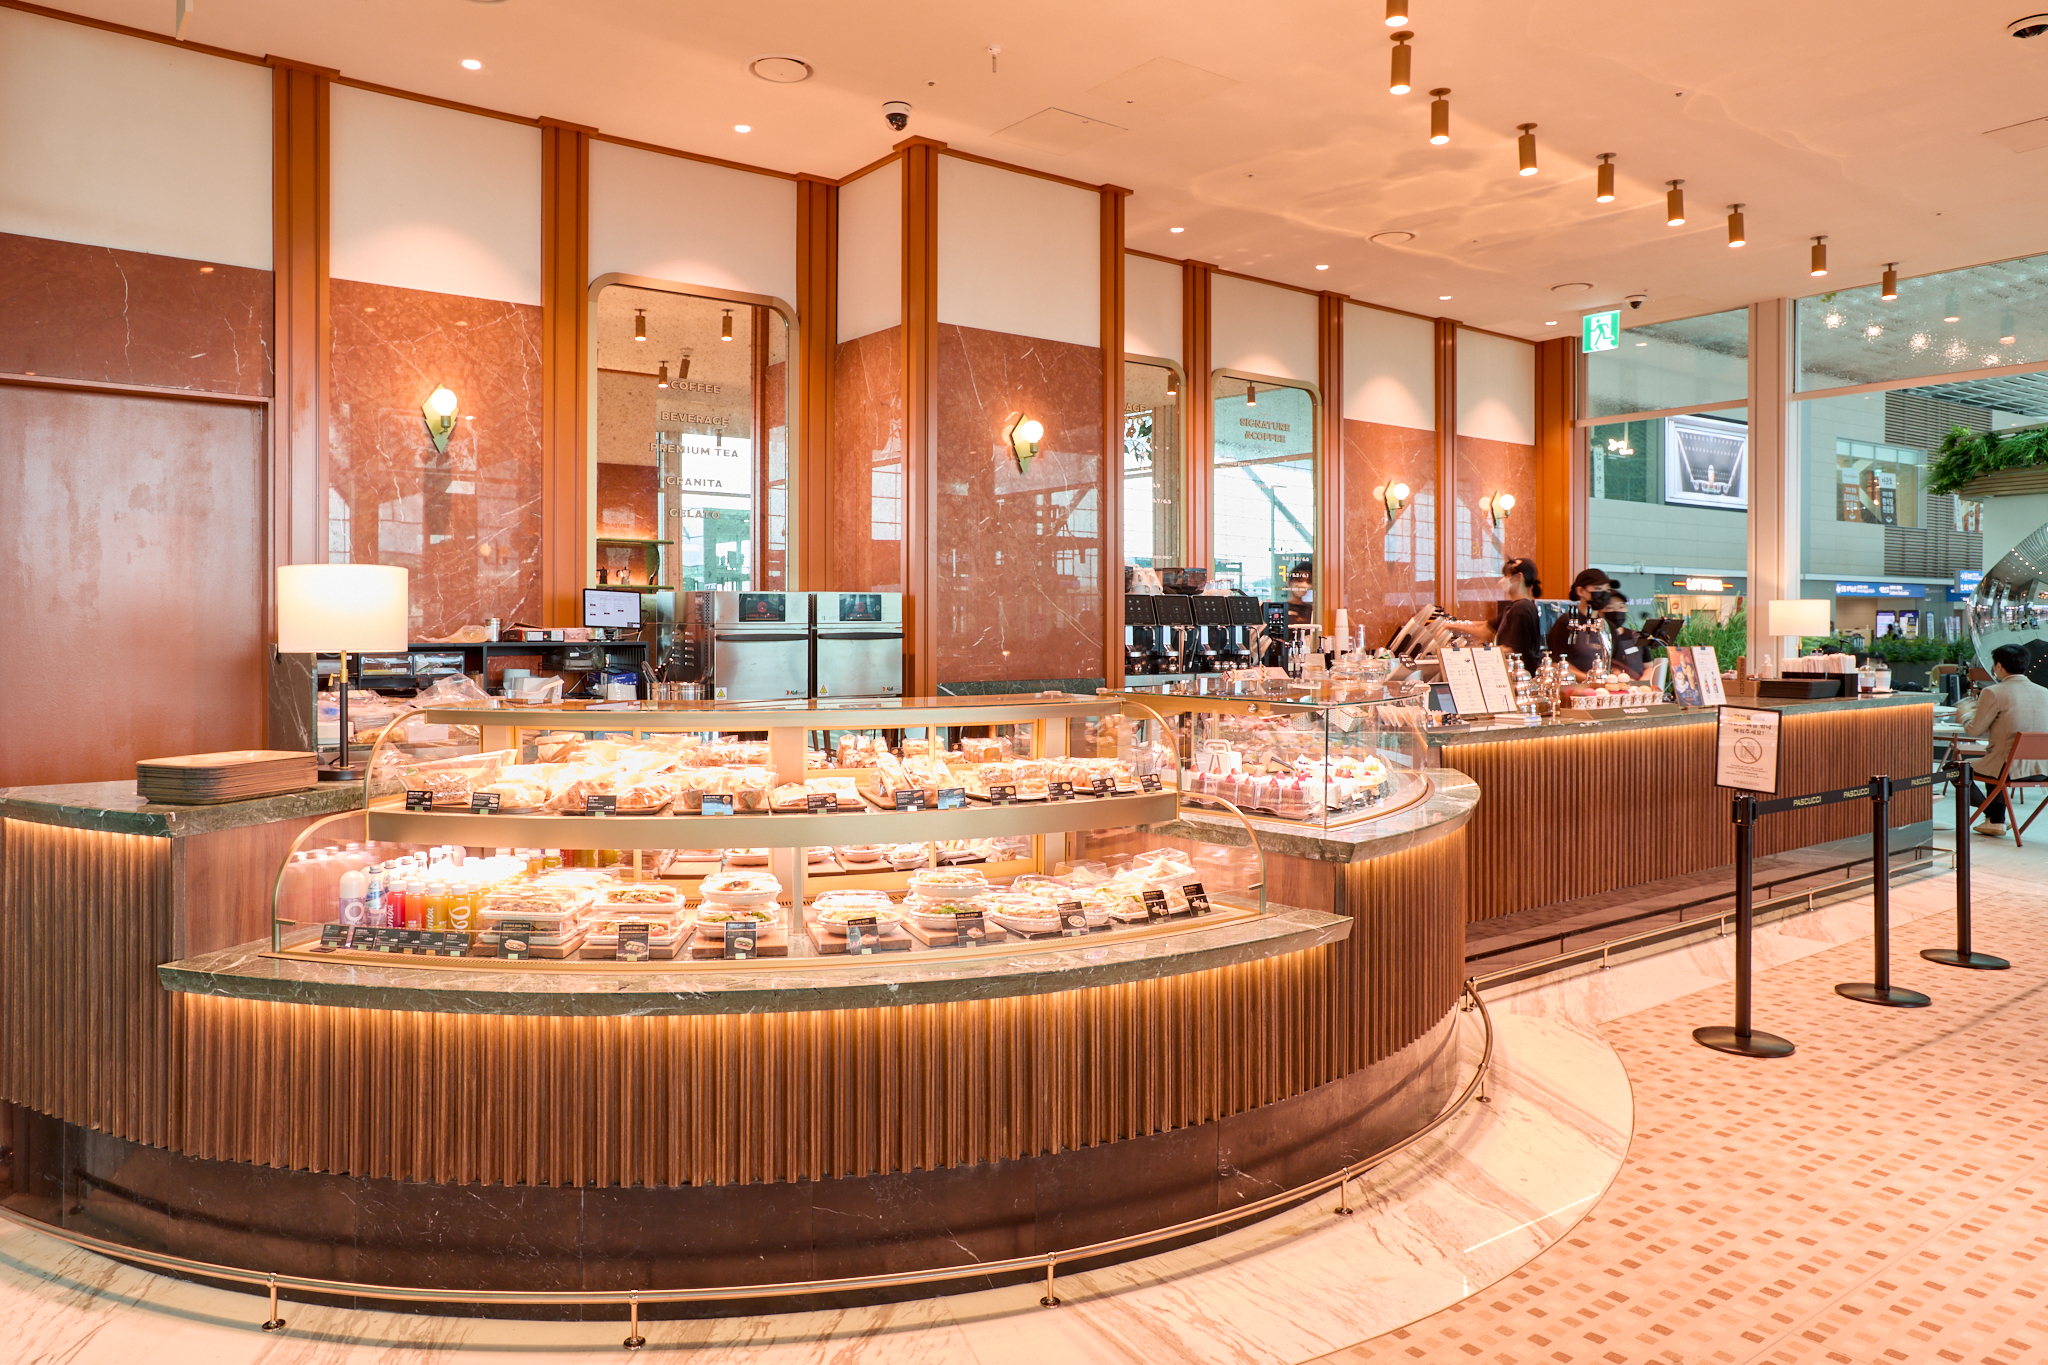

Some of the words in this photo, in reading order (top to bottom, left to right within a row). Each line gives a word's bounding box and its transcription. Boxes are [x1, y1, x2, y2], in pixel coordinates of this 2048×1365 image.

[670, 380, 721, 395] COFFEE
[660, 411, 729, 426] BEVERAGE
[1240, 418, 1290, 432] SIGNATURE
[1244, 430, 1286, 443] &COFFEE
[650, 442, 710, 456] PREMIUM
[715, 448, 738, 458] TEA
[666, 476, 722, 488] GRANITA
[669, 508, 721, 520] GELATO
[1911, 776, 1932, 786] PASCUCCI
[1843, 787, 1869, 799] PASCUCCI
[1793, 795, 1822, 807] PASCUCCI
